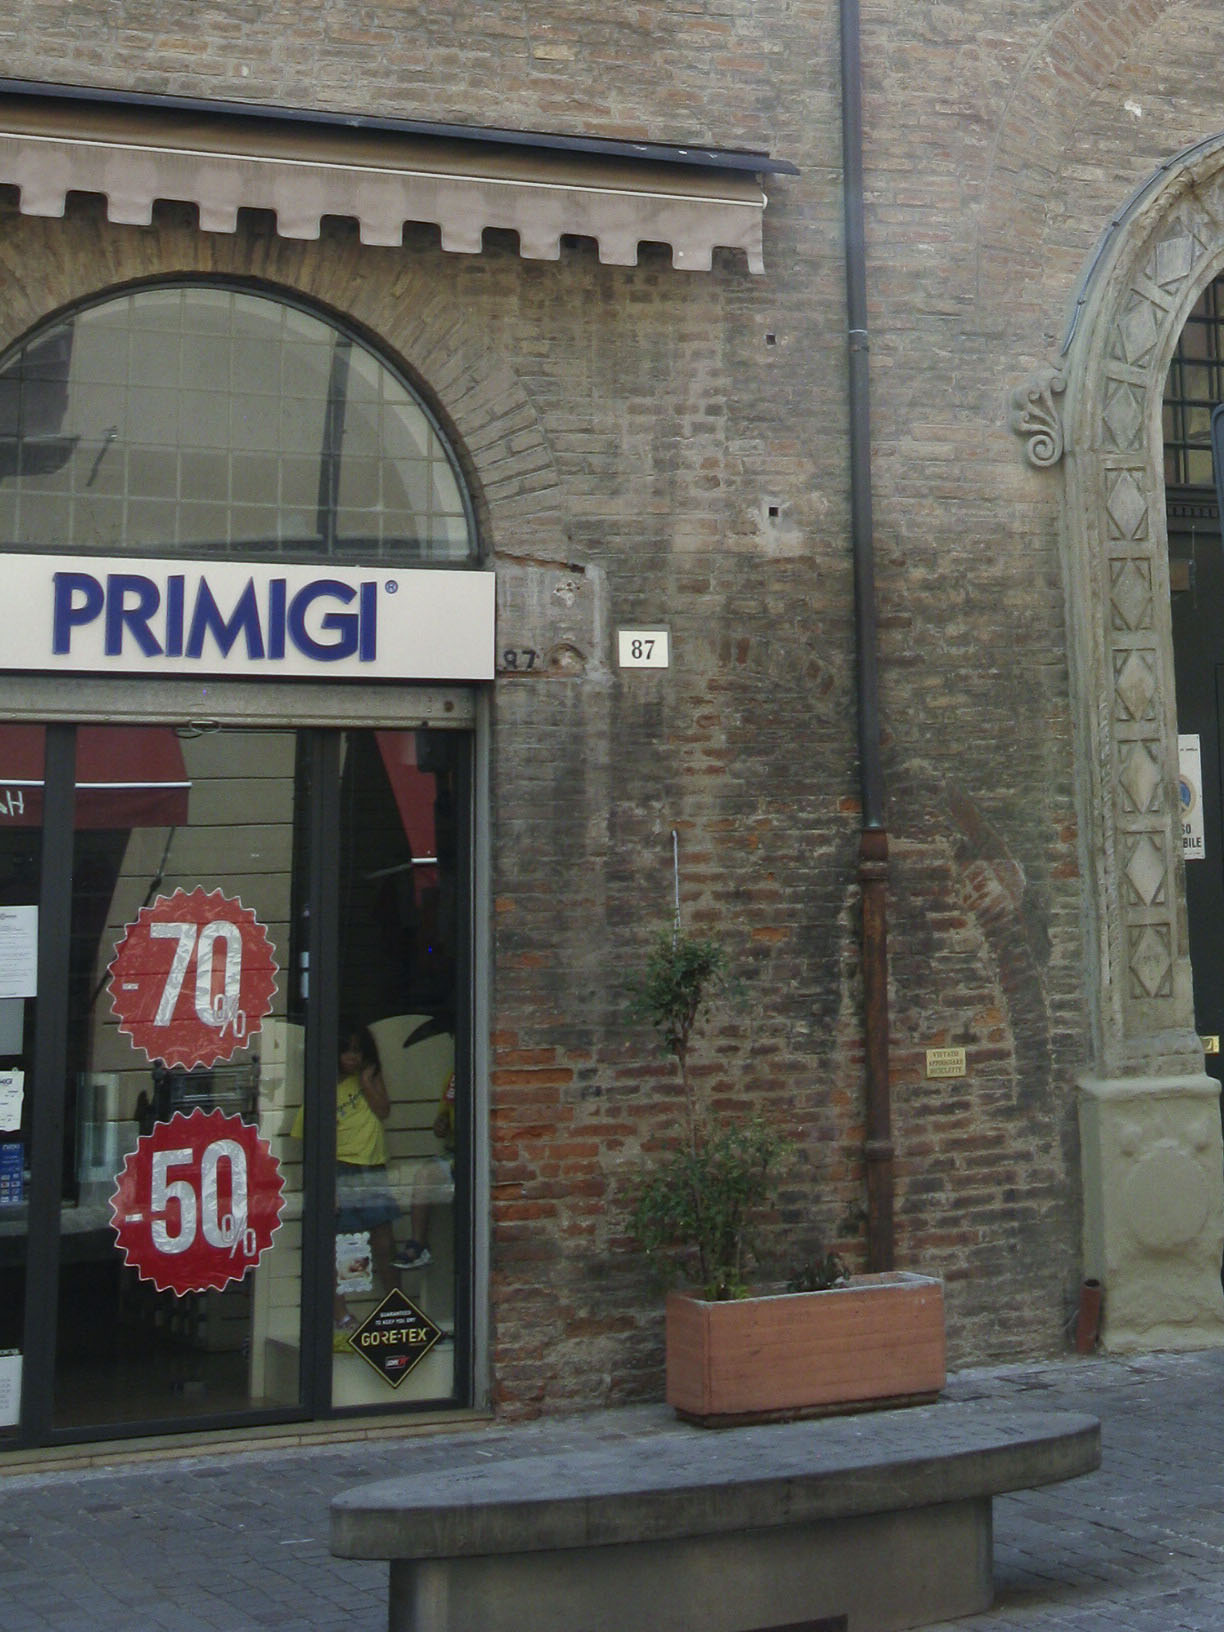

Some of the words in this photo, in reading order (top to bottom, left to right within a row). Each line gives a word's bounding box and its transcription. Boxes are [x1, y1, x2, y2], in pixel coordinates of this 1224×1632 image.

[52, 571, 378, 664] PRIMIGI
[631, 639, 656, 660] 87
[361, 1328, 427, 1346] GORE-TEX
